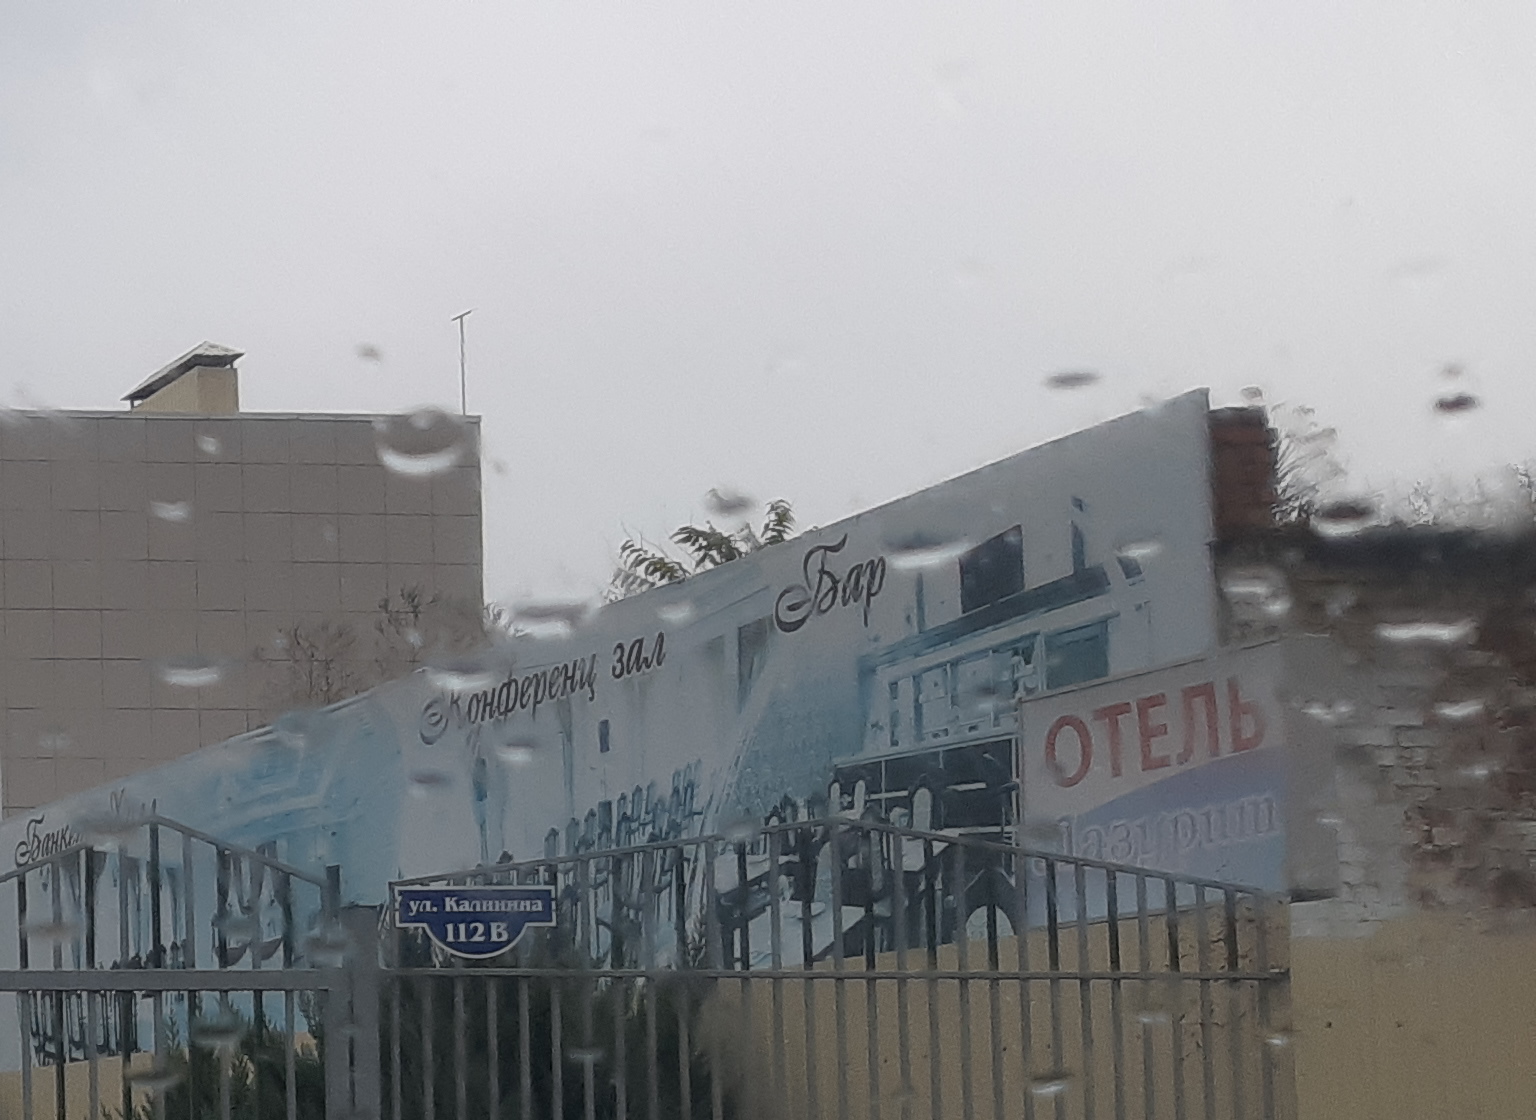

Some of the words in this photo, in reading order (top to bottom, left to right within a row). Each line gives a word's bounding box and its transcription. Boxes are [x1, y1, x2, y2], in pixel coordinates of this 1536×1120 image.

[774, 532, 887, 633] Бар
[611, 631, 667, 680] зал
[1044, 675, 1268, 788] ОТЕЛЬ
[408, 899, 438, 917] ул.
[443, 896, 544, 913] Калинина
